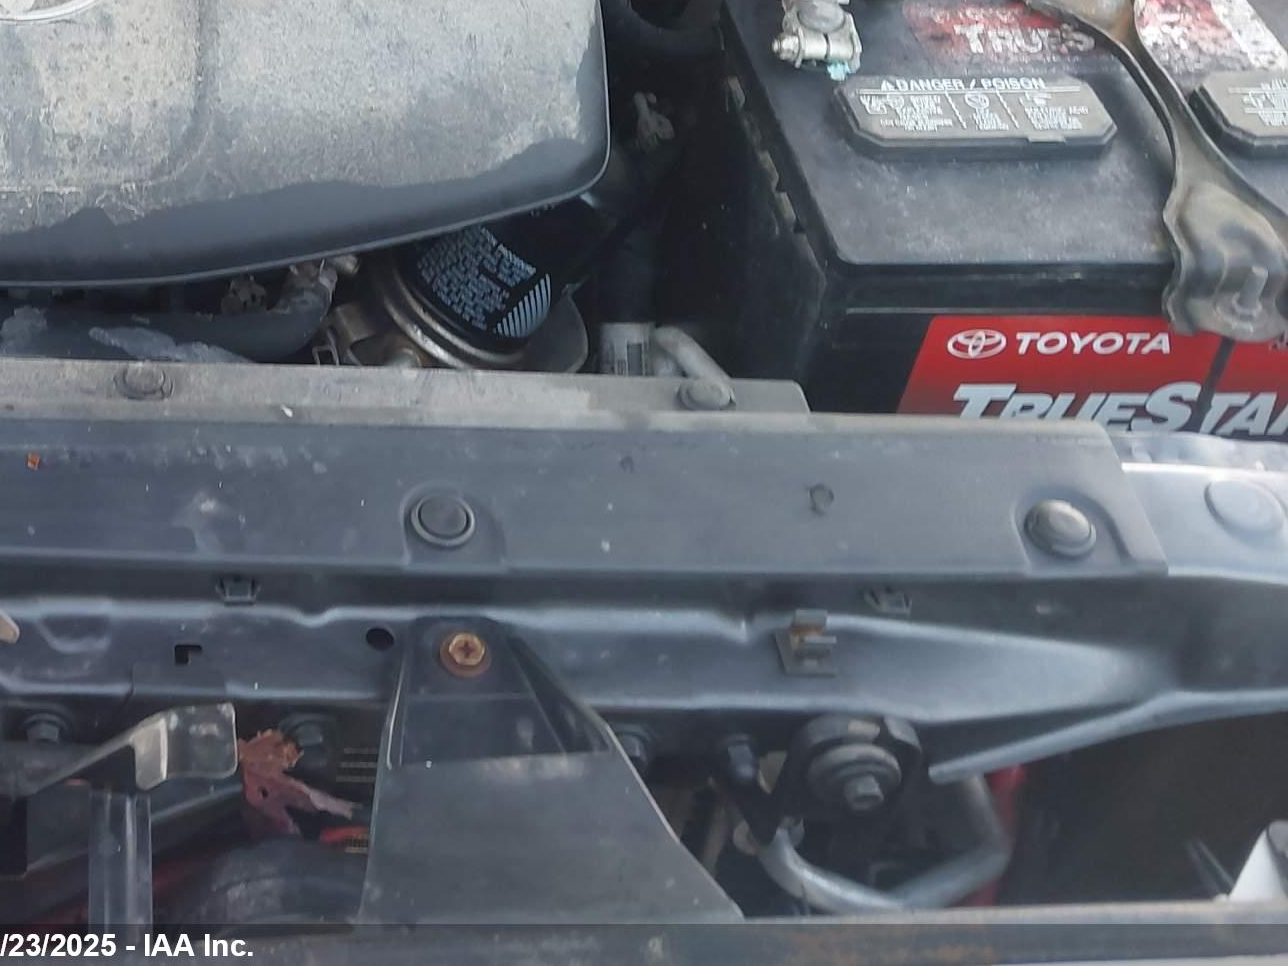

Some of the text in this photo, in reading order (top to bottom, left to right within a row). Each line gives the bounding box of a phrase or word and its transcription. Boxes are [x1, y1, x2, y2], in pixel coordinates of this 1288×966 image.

[893, 77, 965, 91] DANGER
[980, 76, 1047, 90] POISON
[1016, 331, 1171, 355] TOYOTA
